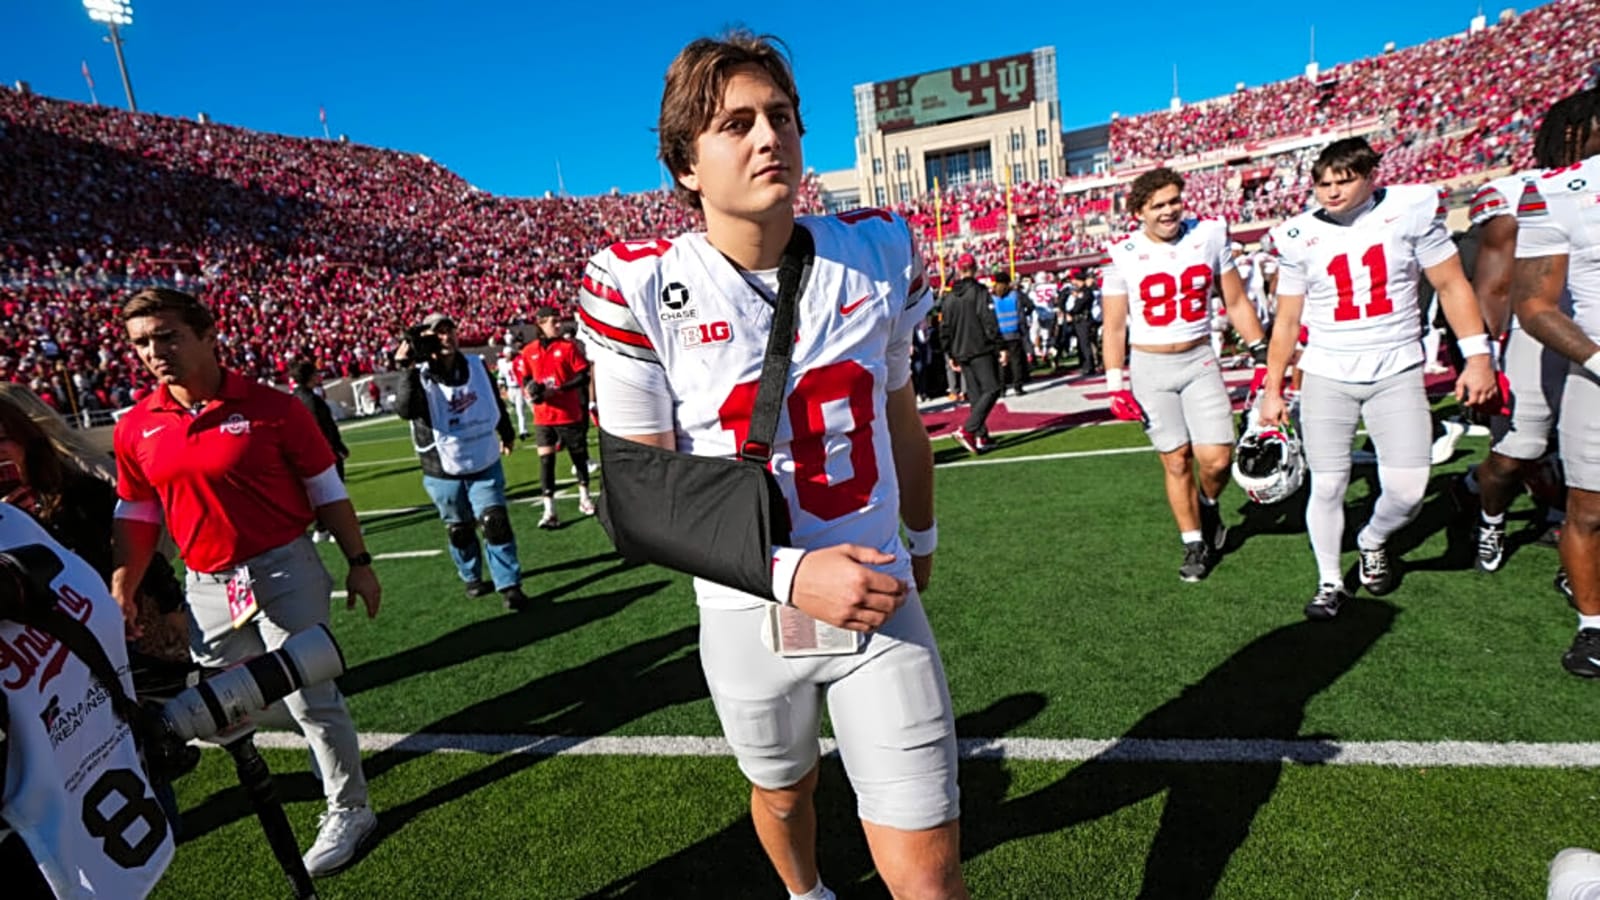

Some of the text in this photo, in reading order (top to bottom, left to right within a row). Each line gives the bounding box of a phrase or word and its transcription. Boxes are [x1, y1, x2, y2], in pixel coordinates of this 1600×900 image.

[660, 309, 697, 321] CHASE
[1139, 263, 1213, 326] 88
[1326, 243, 1394, 322] 11
[82, 768, 168, 869] 8
